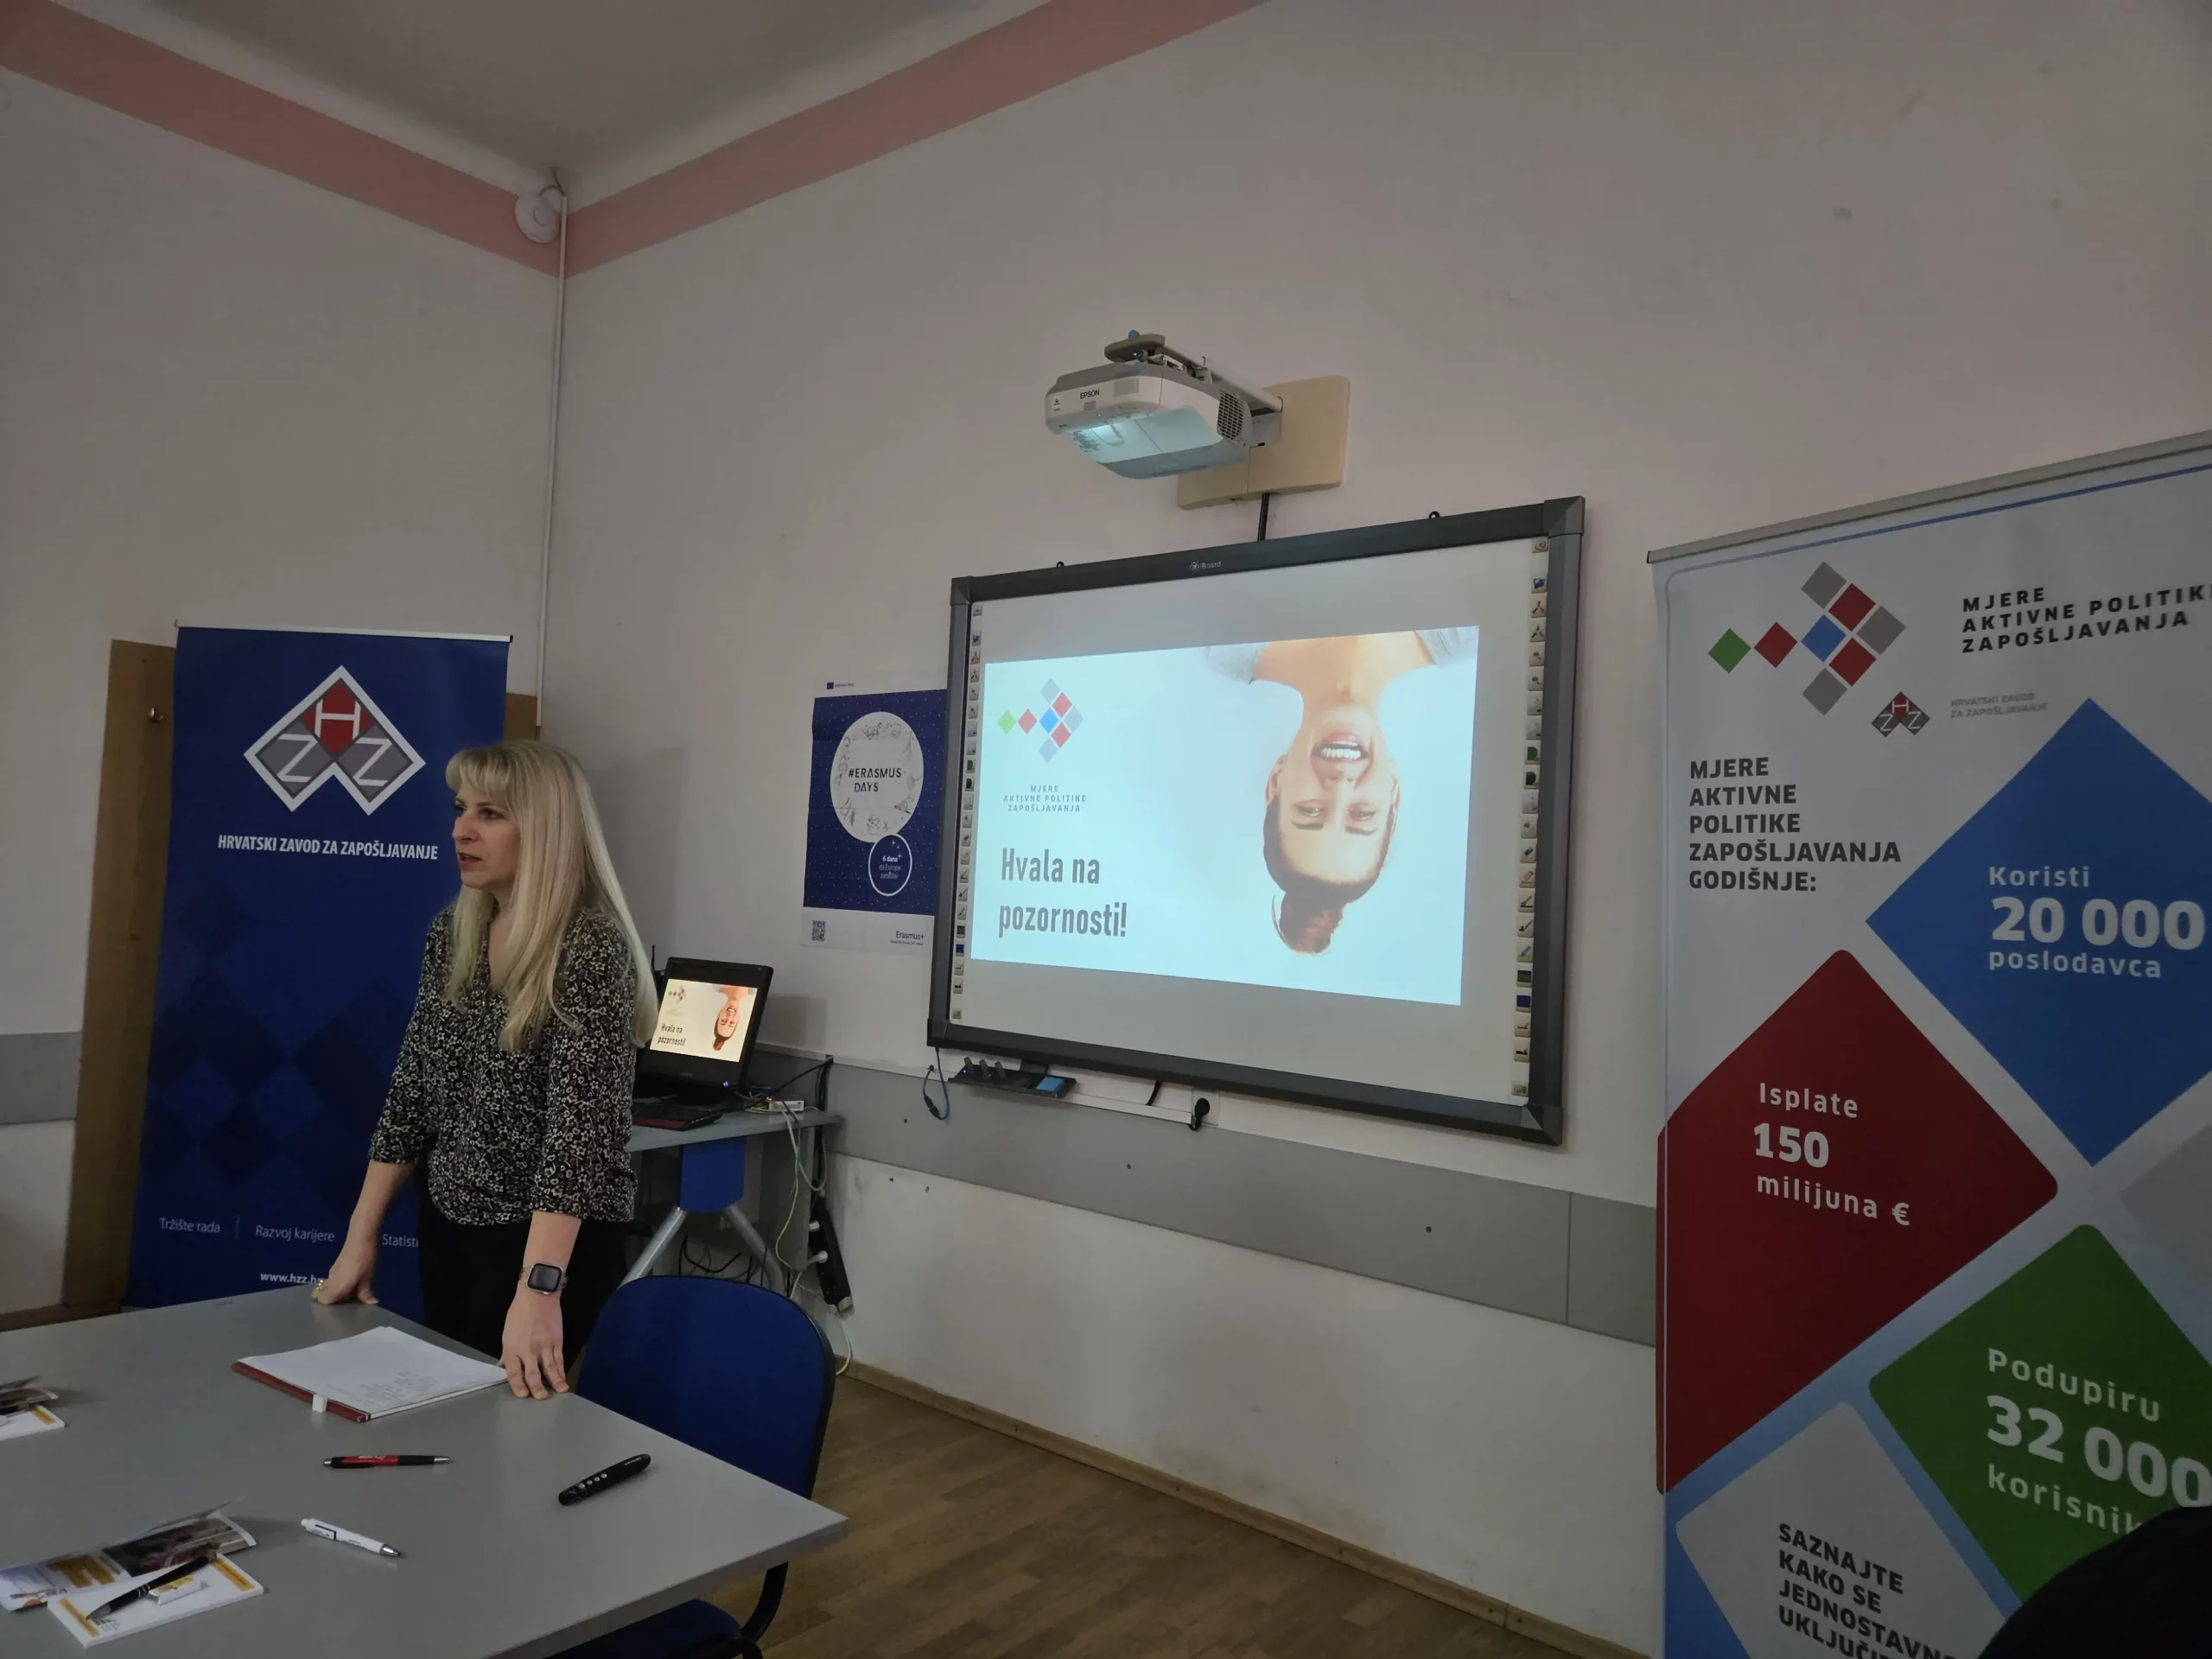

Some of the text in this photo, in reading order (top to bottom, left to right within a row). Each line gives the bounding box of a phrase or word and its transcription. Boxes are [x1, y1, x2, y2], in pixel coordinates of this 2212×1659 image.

[1080, 390, 1100, 399] EPSON
[1962, 588, 2045, 613] MJERE
[1962, 583, 2212, 632] AKTIVNE POLITIK
[1962, 611, 2190, 653] ZAPOŠLJAVANJA
[1950, 696, 1999, 707] HRVATSKI
[1950, 709, 1964, 718] ZA
[849, 767, 902, 779] #ERASMUS
[1690, 757, 1770, 779] MJERE
[854, 782, 879, 792] DAYS
[1689, 785, 1796, 806] AKTIVNE
[1007, 804, 1081, 812] ZAPOŠLJAVANJA
[1689, 813, 1801, 834] POLITIKE
[218, 835, 438, 861] HRVATSKI ZAVOD ZA ZAPOŠLJAVANJE
[1689, 839, 1902, 862] ZAPOŠLJAVANJA
[1001, 848, 1101, 885] Hvala na
[1989, 866, 2089, 887] Koristi
[1689, 868, 1816, 892] GODIŠNJE:
[998, 902, 1128, 938] pozornosti!
[1992, 896, 2205, 950] 20 000
[895, 931, 925, 941] Erasmus+
[1989, 950, 2161, 978] poslodavca
[1760, 1083, 1859, 1118] Isplate
[1754, 1122, 1829, 1168] 150
[1758, 1175, 1910, 1226] milijuna €
[159, 1217, 194, 1232] Tržište
[196, 1220, 220, 1234] rada
[255, 1225, 292, 1242] Razvoj
[295, 1227, 335, 1243] karijere
[260, 1273, 325, 1284] www.hzz.h
[1988, 1347, 2160, 1422] Podupiru
[1986, 1395, 2212, 1508] 32 000
[1779, 1522, 1904, 1595] SAZNAJTE
[1779, 1549, 1882, 1614] KAKO SE
[1779, 1580, 1957, 1659] JEDNOSTAVN
